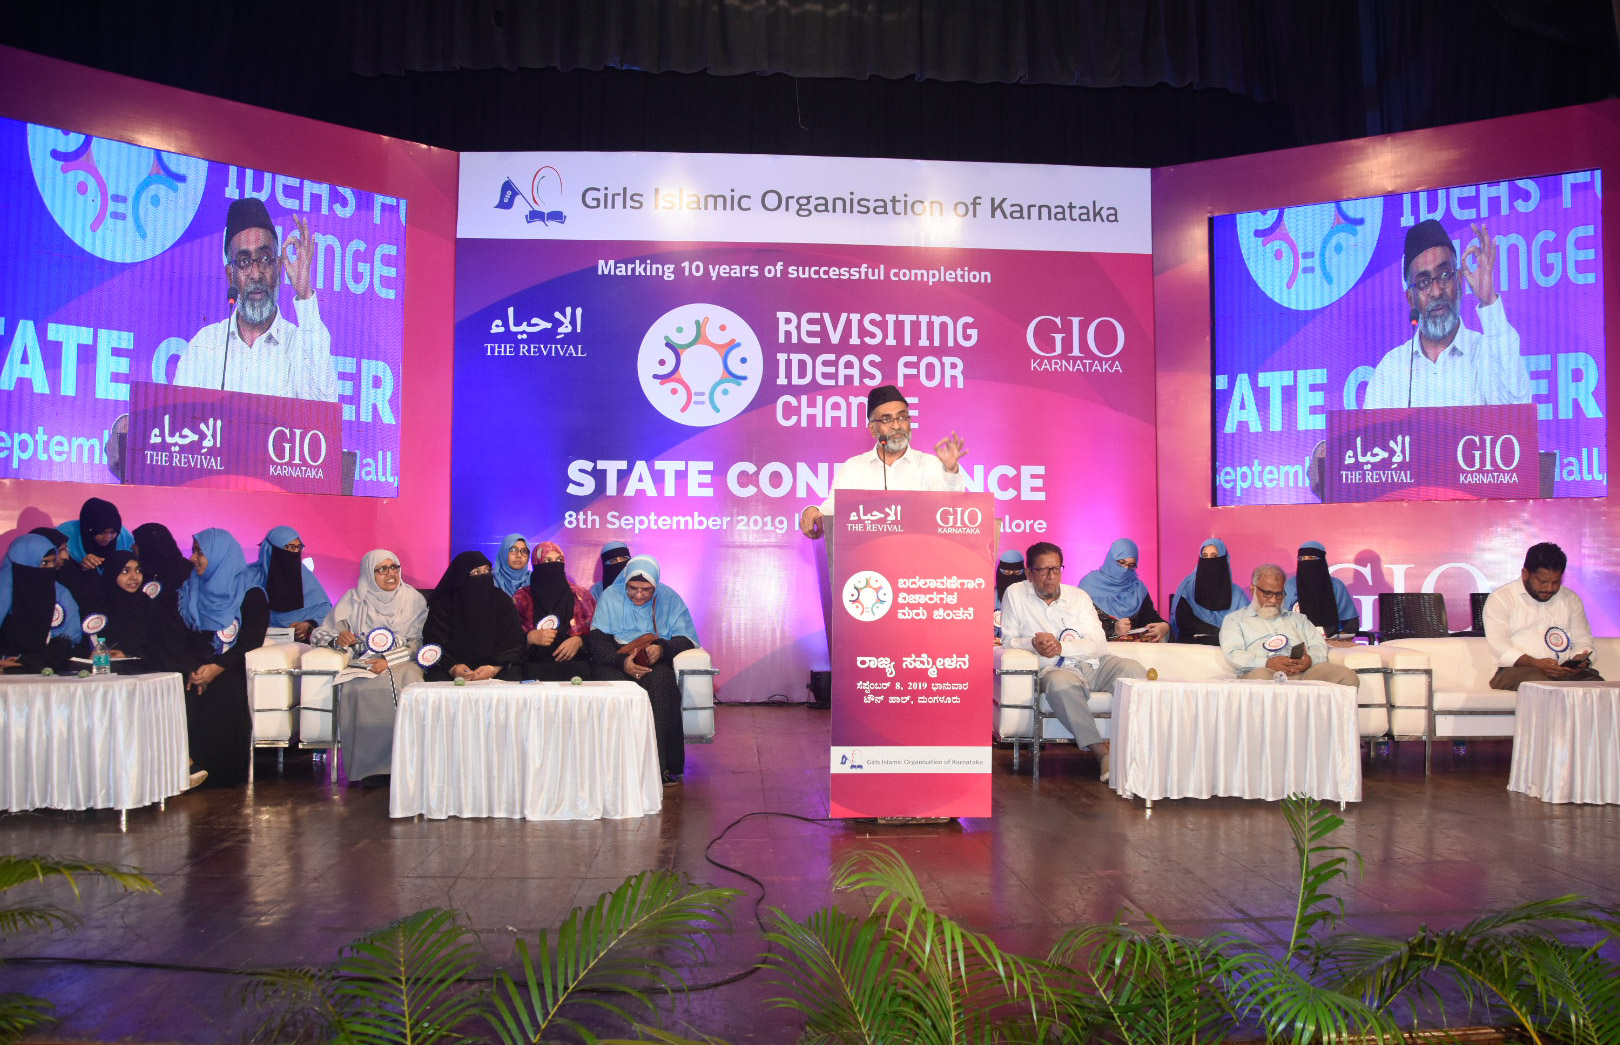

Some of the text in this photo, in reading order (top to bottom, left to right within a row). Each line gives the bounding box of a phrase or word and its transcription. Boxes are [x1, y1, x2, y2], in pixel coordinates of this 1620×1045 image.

[581, 186, 1119, 223] Girls Islamic Organisation of Karnataka
[597, 259, 992, 286] Marking 10 years of successful completion
[776, 311, 979, 348] REVISITING
[1026, 315, 1126, 359] GIO
[484, 343, 587, 358] THE REVIVAL
[776, 353, 965, 389] IDEAS FOR
[1031, 359, 1123, 374] KARNATAKA
[776, 395, 919, 429] CHANE
[267, 426, 327, 466] GIO
[1456, 434, 1521, 471] GIO
[145, 450, 225, 470] THE REVIVAL
[269, 464, 325, 480] KARNATAKA
[566, 459, 1047, 501] STATE CONNCE
[1341, 470, 1415, 484] THE REVIVAL
[1459, 472, 1519, 484] KARNATAKA
[564, 511, 600, 530] 8th
[606, 511, 731, 534] September
[736, 515, 788, 534] 2019
[846, 523, 904, 533] THE REVIVAL
[936, 507, 983, 528] GIO
[938, 527, 981, 535] KARNATAKA
[897, 606, 928, 620] ಮರು
[907, 681, 928, 690] 2019
